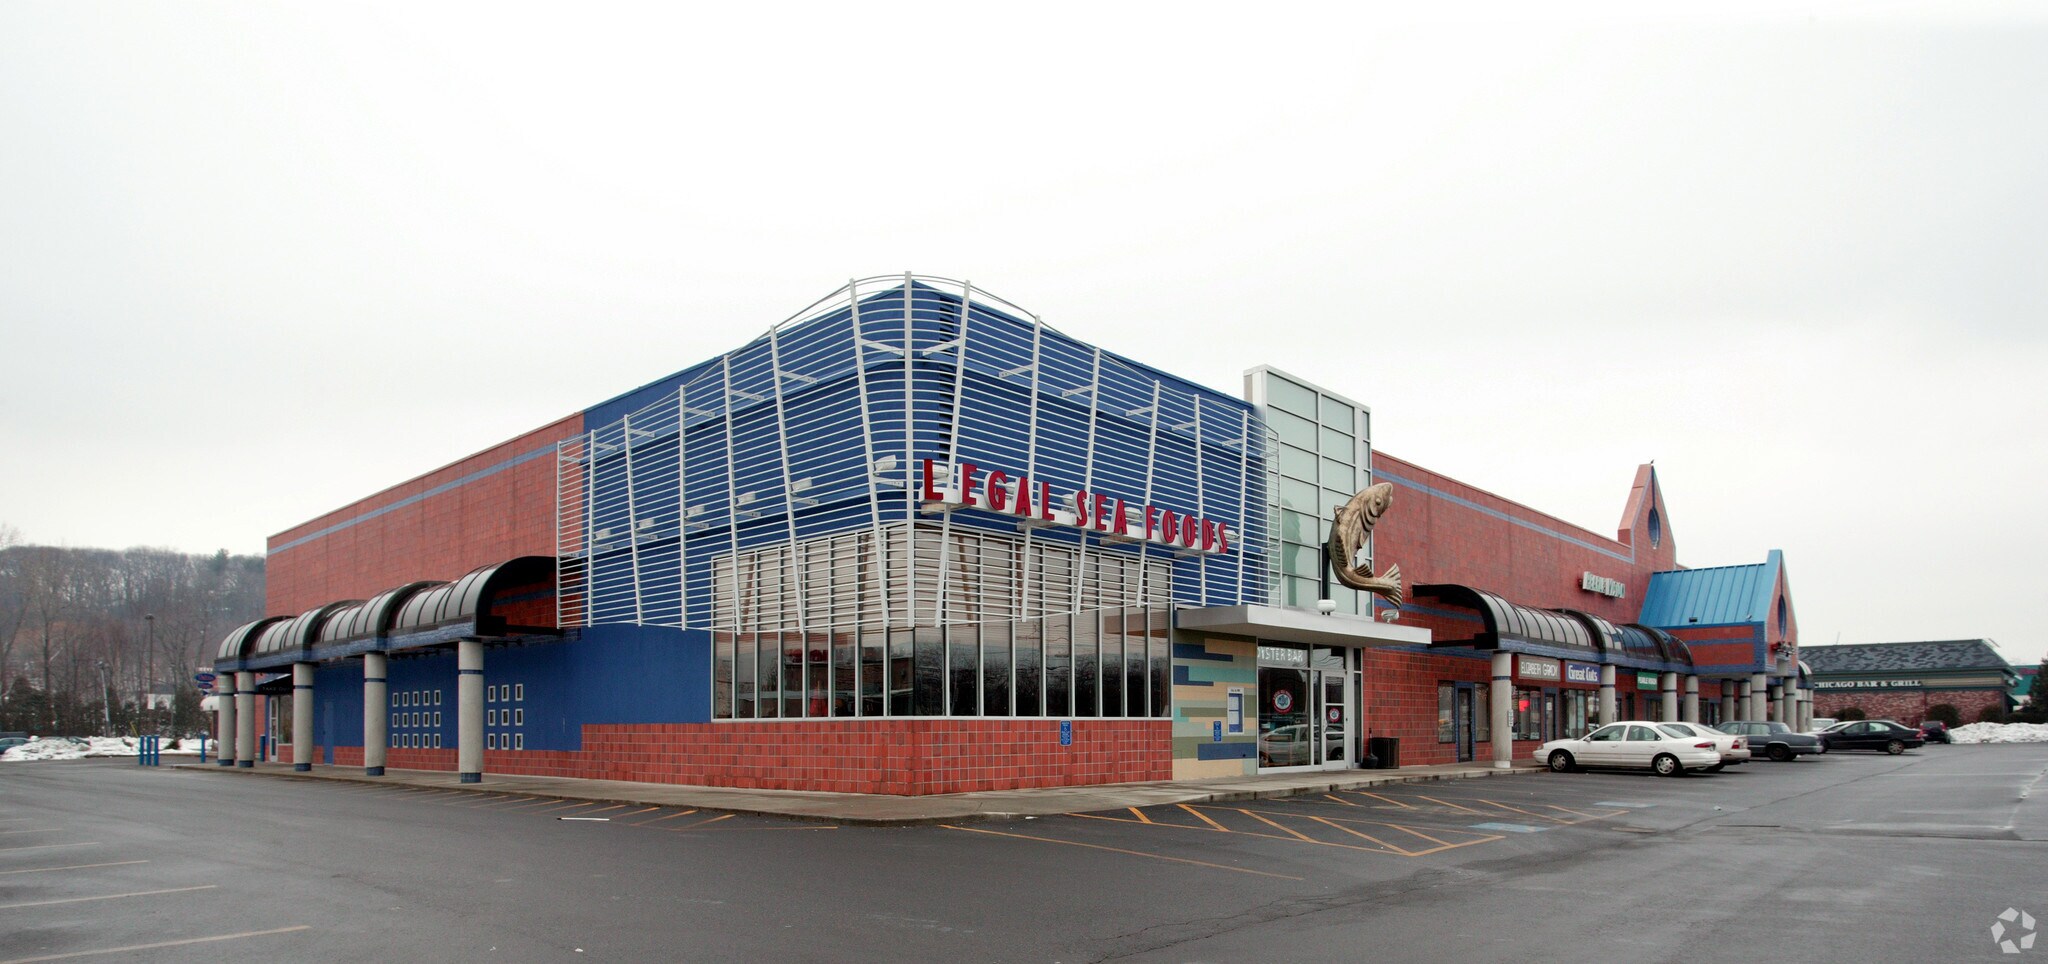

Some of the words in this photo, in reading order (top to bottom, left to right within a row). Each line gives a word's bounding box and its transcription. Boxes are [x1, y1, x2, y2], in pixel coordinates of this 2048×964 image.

[922, 458, 1055, 521] LEGAL
[1073, 489, 1127, 536] SEA
[1143, 505, 1227, 554] FOODS
[1287, 649, 1303, 662] BAR
[1568, 664, 1586, 680] Great
[1586, 667, 1598, 682] Cuts
